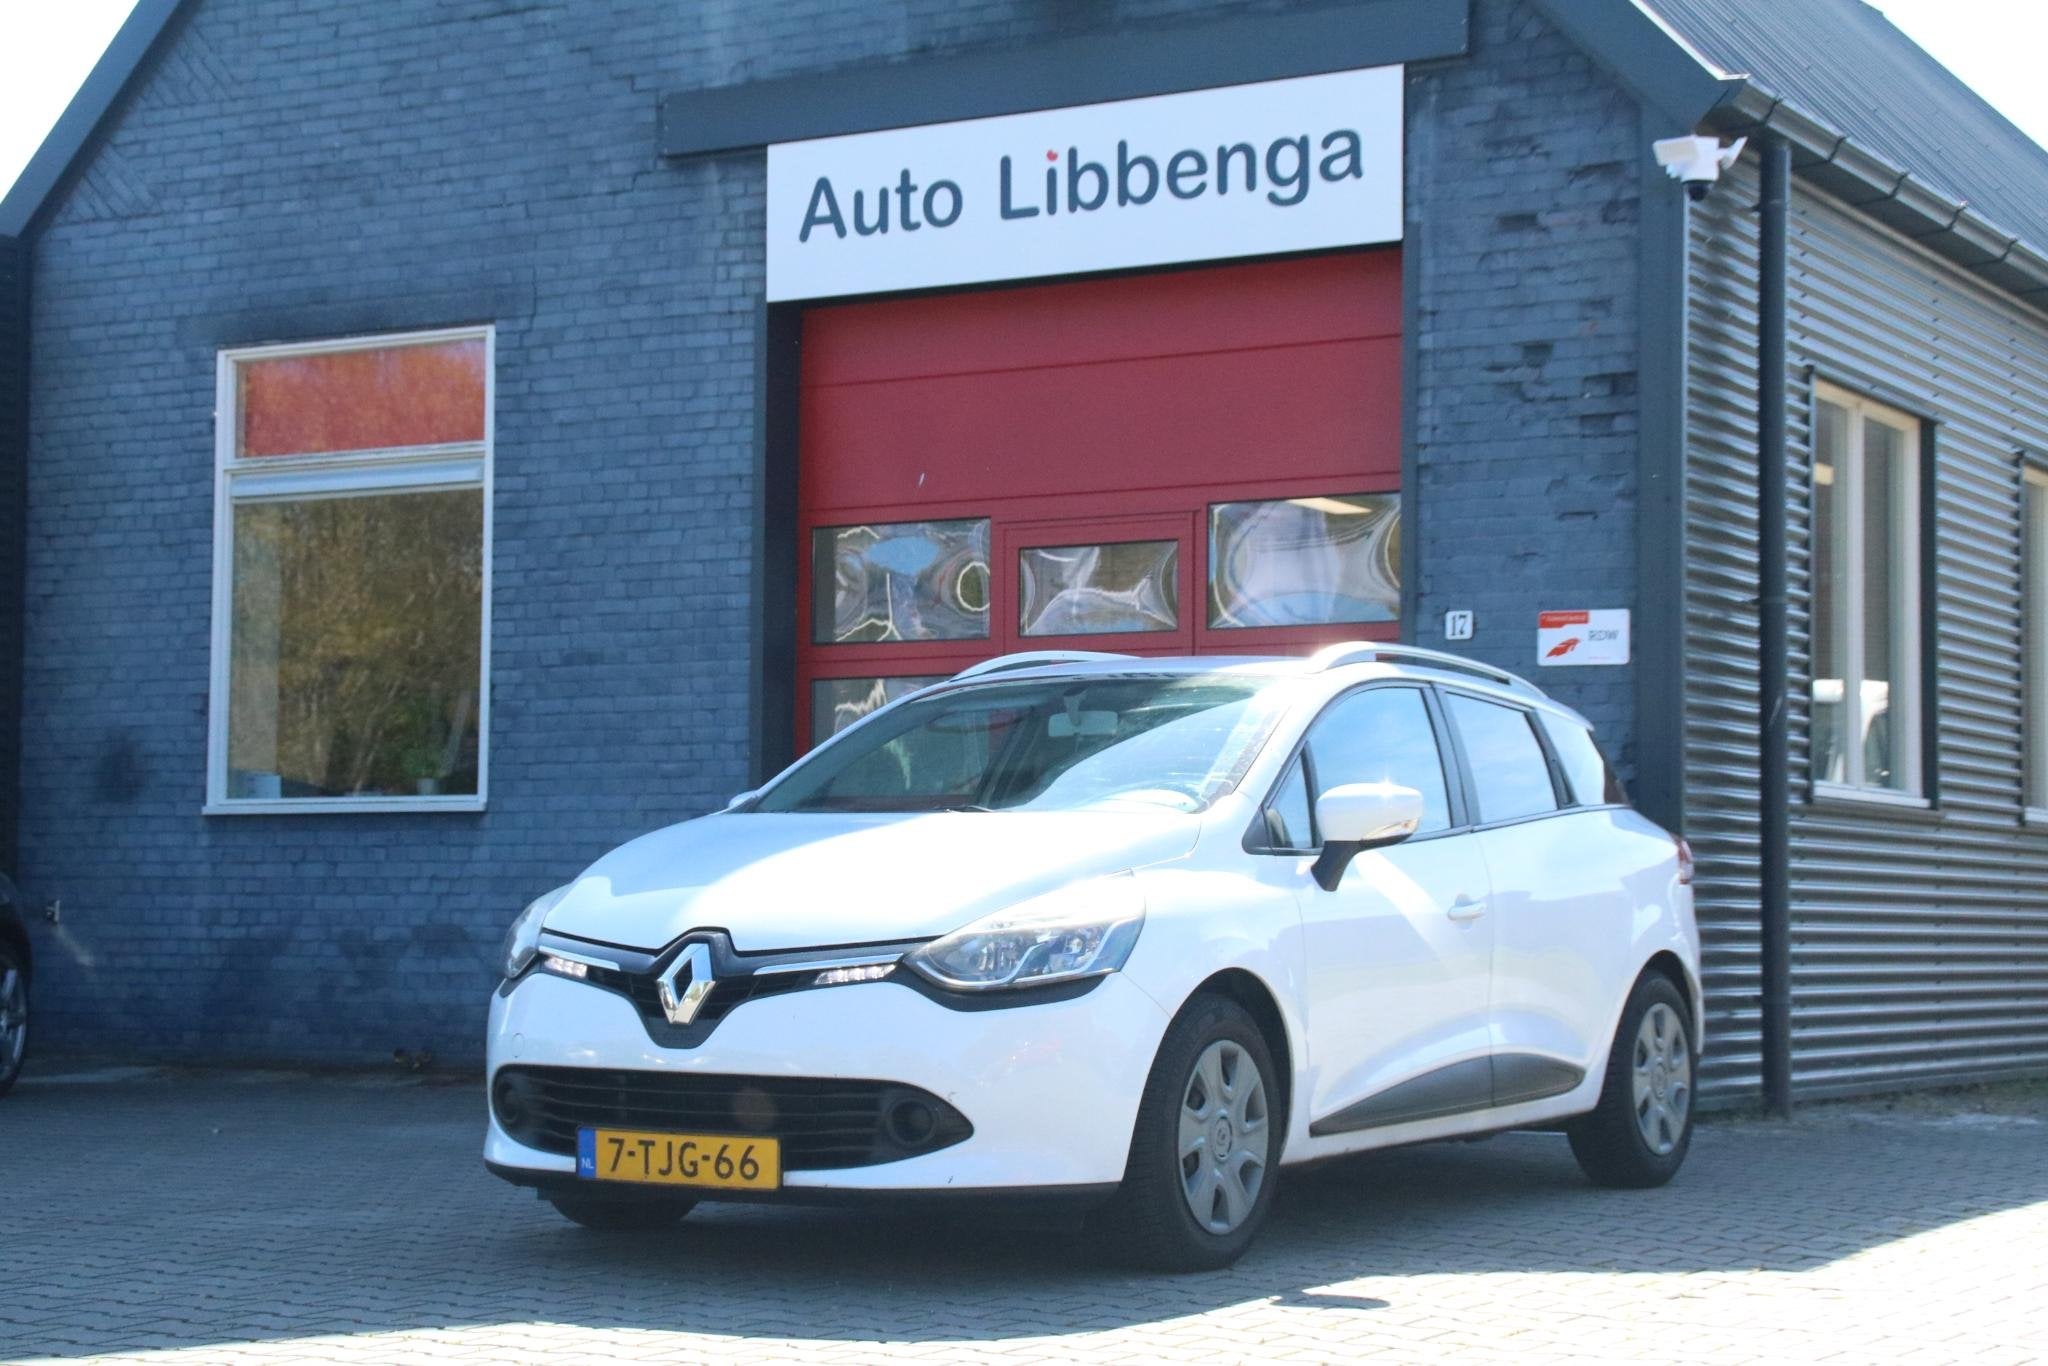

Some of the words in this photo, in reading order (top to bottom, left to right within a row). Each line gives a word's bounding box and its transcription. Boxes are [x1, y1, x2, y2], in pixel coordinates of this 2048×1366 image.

[799, 168, 963, 243] Auto
[1000, 127, 1364, 220] Libbenga
[1450, 613, 1468, 637] 17
[581, 1156, 594, 1169] NL
[608, 1137, 760, 1181] 7-TJG-66
